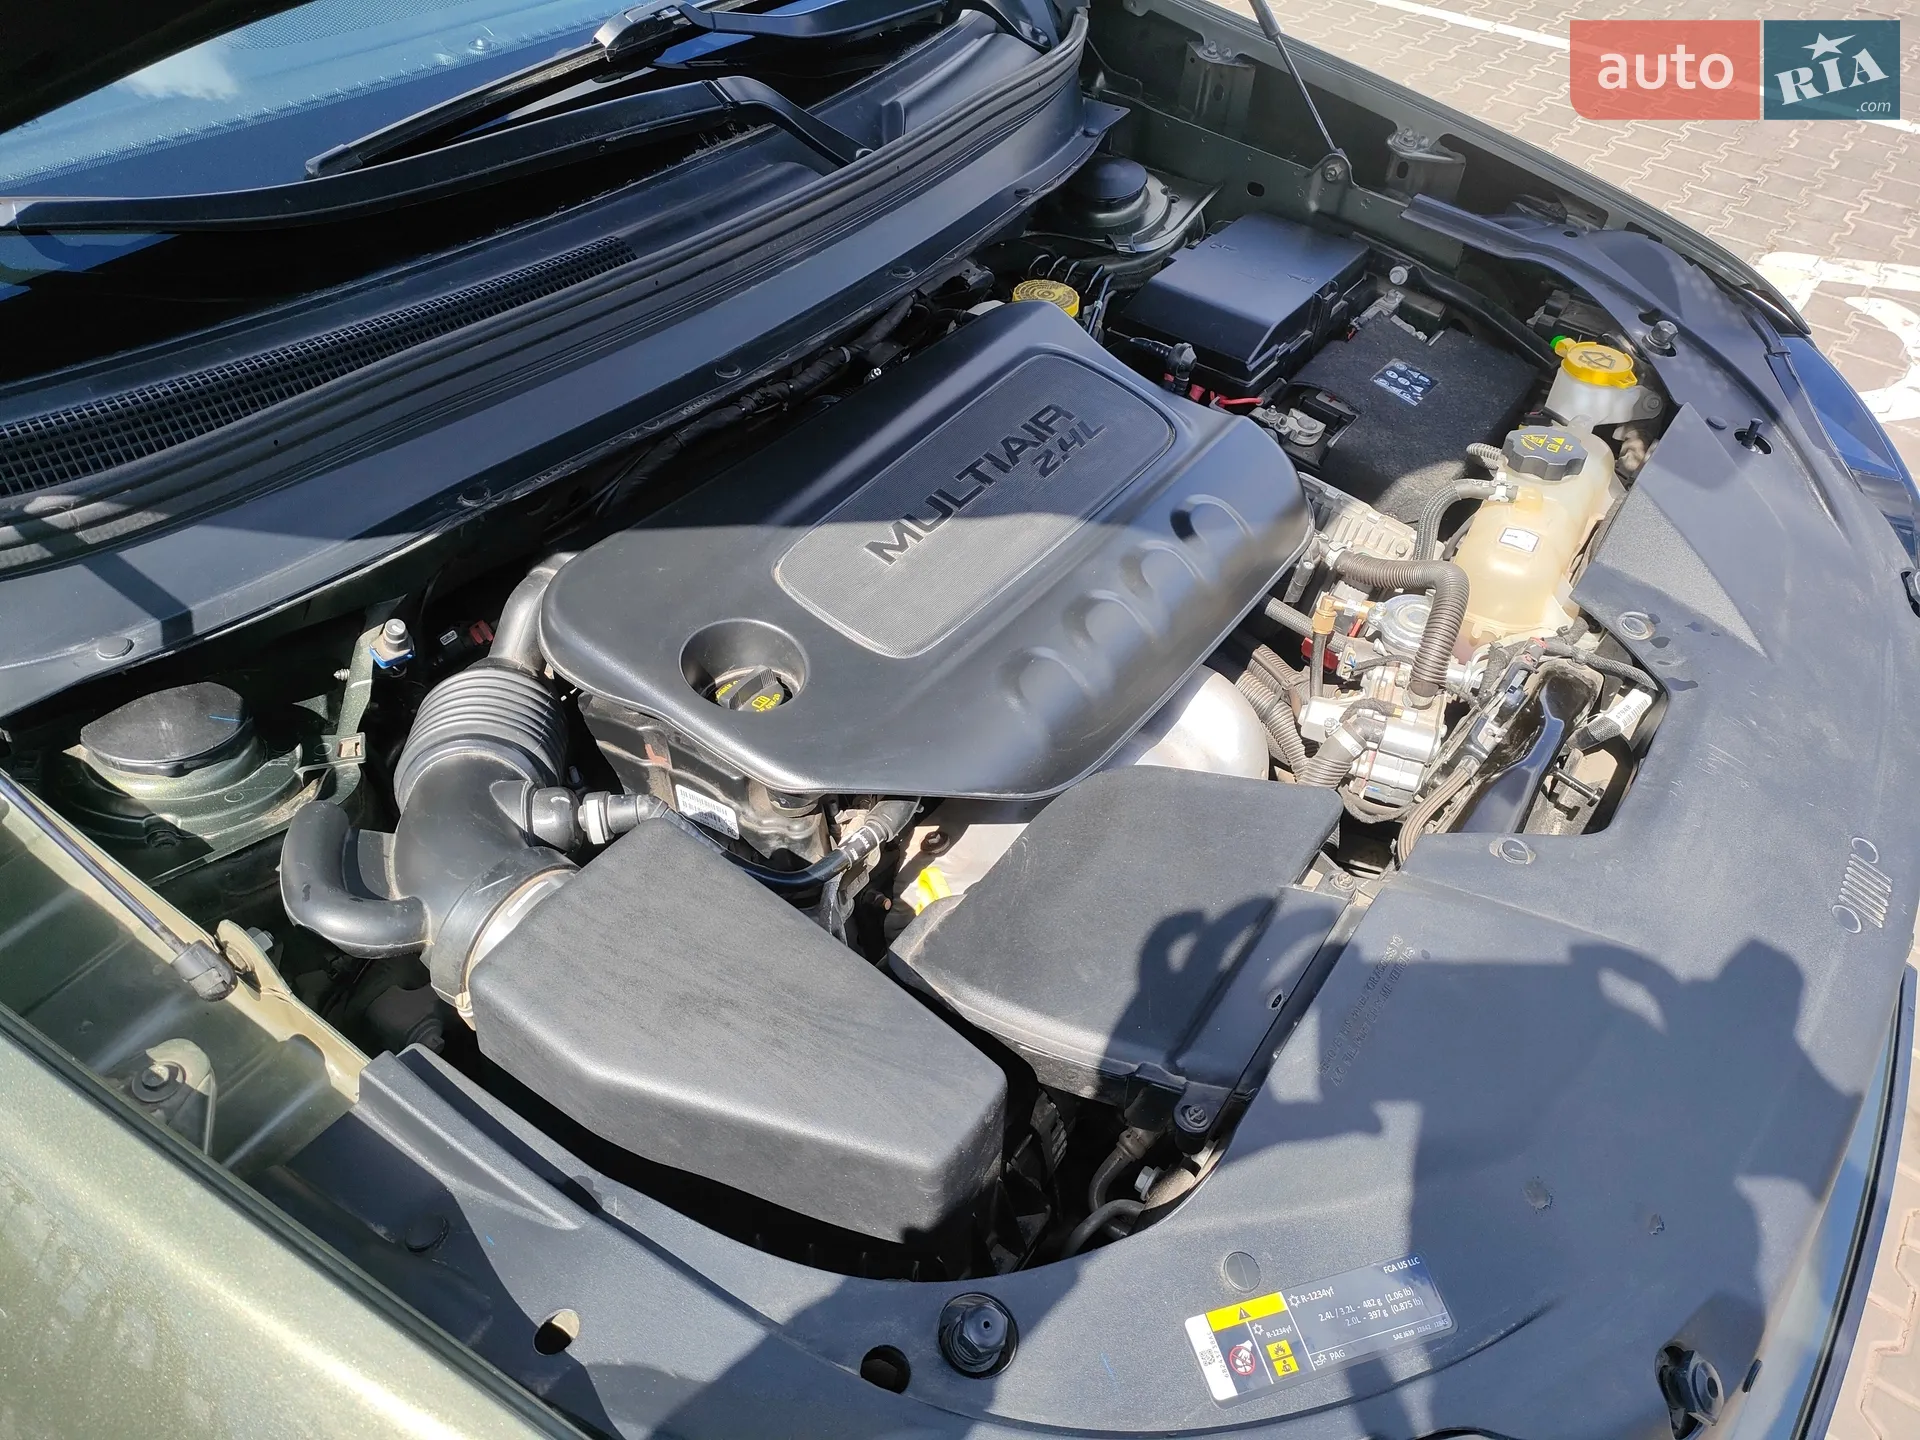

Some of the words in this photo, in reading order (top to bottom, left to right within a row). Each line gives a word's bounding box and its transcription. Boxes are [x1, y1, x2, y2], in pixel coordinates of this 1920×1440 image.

[1031, 420, 1108, 478] 2.4L
[863, 403, 1076, 566] MULTIAIR
[1391, 933, 1404, 947] TO
[1383, 1263, 1398, 1275] FCA
[1397, 1260, 1408, 1270] US
[1407, 1256, 1421, 1266] LLC
[1300, 1286, 1334, 1304] R-1234yf
[1318, 1309, 1335, 1323] 2.4L
[1340, 1303, 1355, 1316] 3.2L
[1362, 1298, 1376, 1309] 482
[1385, 1290, 1404, 1303] (1.06
[1404, 1286, 1414, 1297] lb)
[1345, 1316, 1361, 1327] 2.0L
[1368, 1309, 1382, 1321] 397
[1390, 1300, 1413, 1315] (0.875
[1413, 1296, 1424, 1307] lb)
[1266, 1324, 1292, 1339] R-1234yf
[1392, 1331, 1403, 1341] SAE
[1329, 1349, 1345, 1361] PAG
